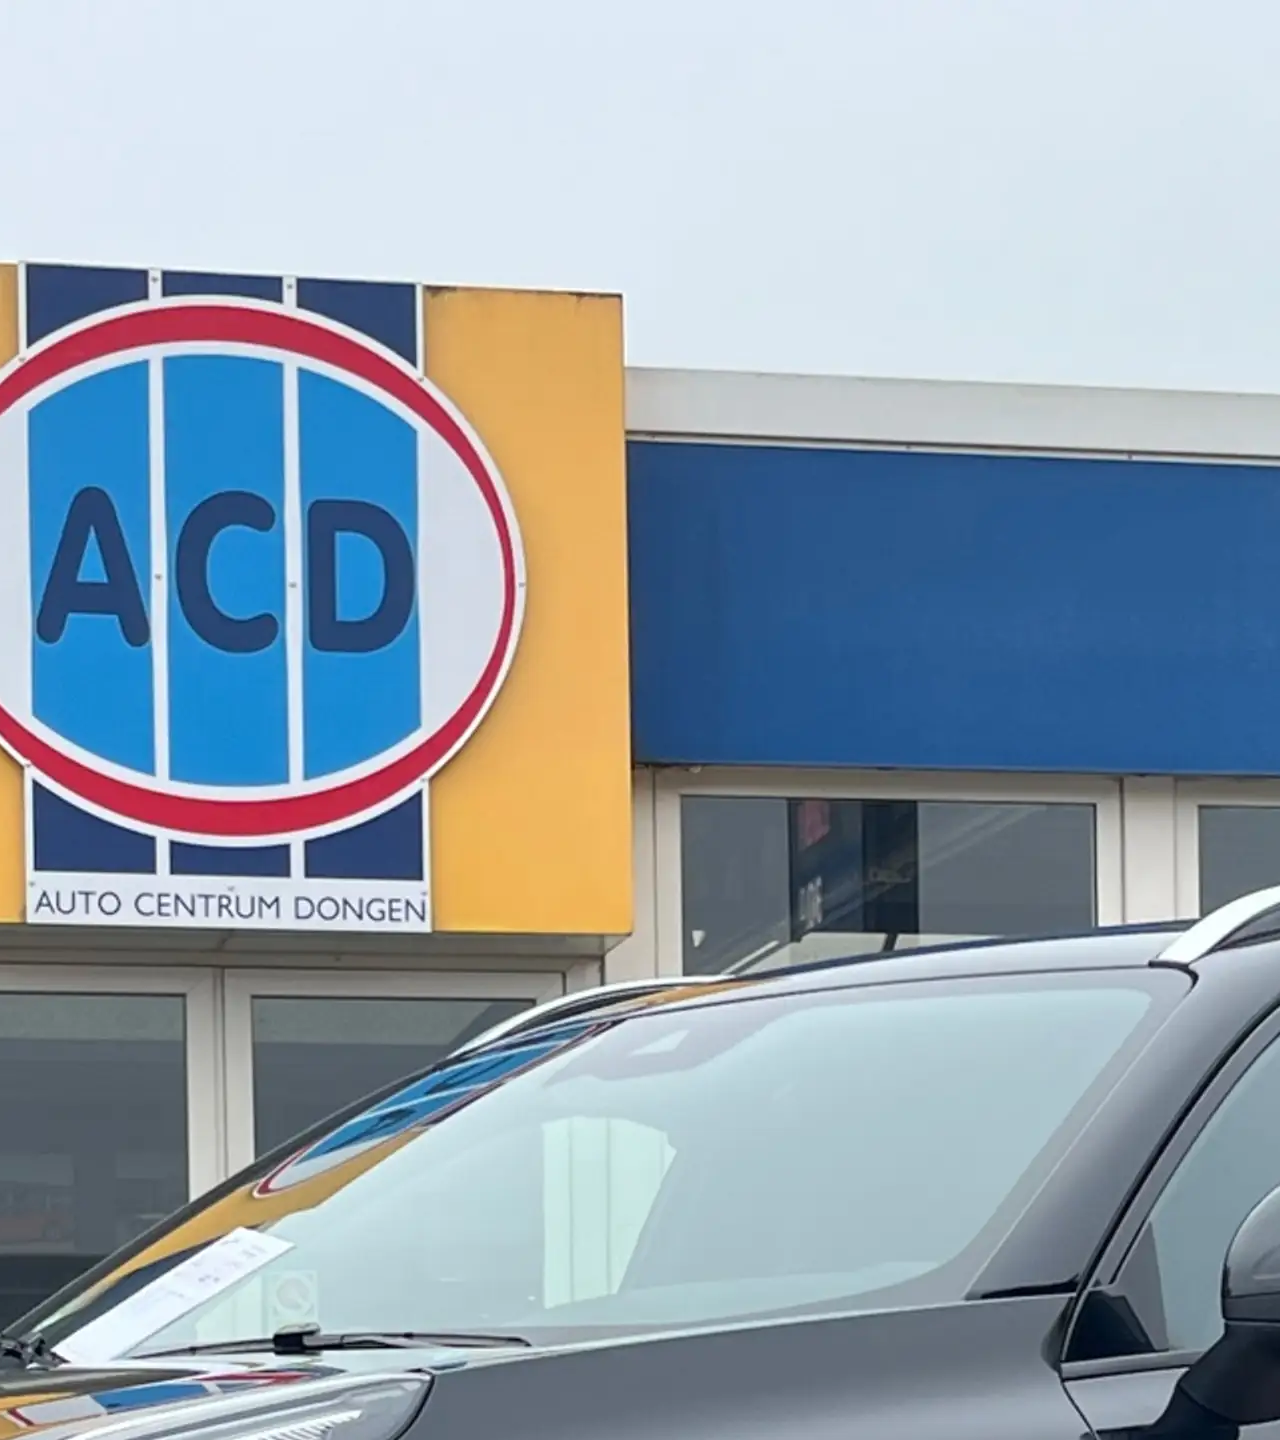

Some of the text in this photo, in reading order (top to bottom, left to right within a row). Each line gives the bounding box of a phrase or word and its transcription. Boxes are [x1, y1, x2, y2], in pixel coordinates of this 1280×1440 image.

[36, 486, 416, 653] ACD
[34, 890, 426, 923] AUTO CENTRUM DONGEN
